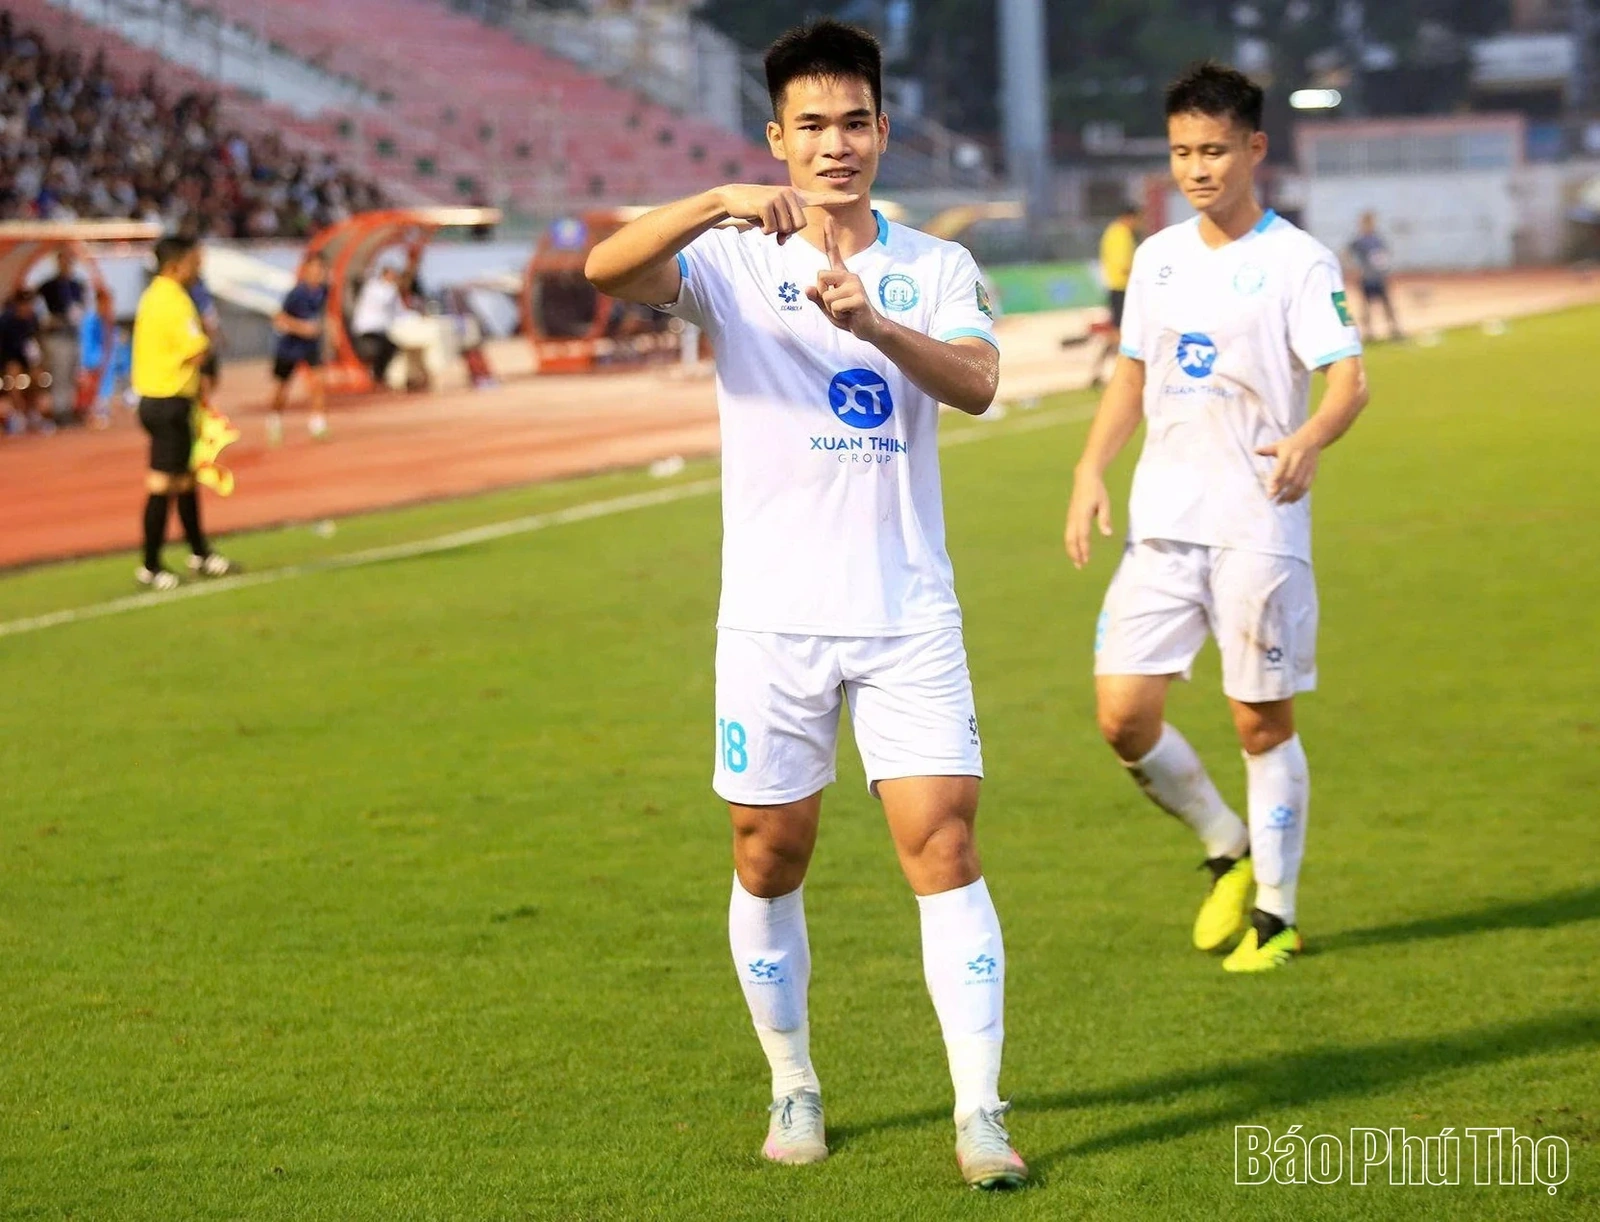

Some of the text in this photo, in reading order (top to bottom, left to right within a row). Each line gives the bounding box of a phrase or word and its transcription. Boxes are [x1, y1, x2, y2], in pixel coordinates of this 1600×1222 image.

[836, 382, 884, 415] XT
[809, 436, 863, 450] XUAN
[838, 453, 892, 464] GROUP
[719, 718, 748, 774] 18
